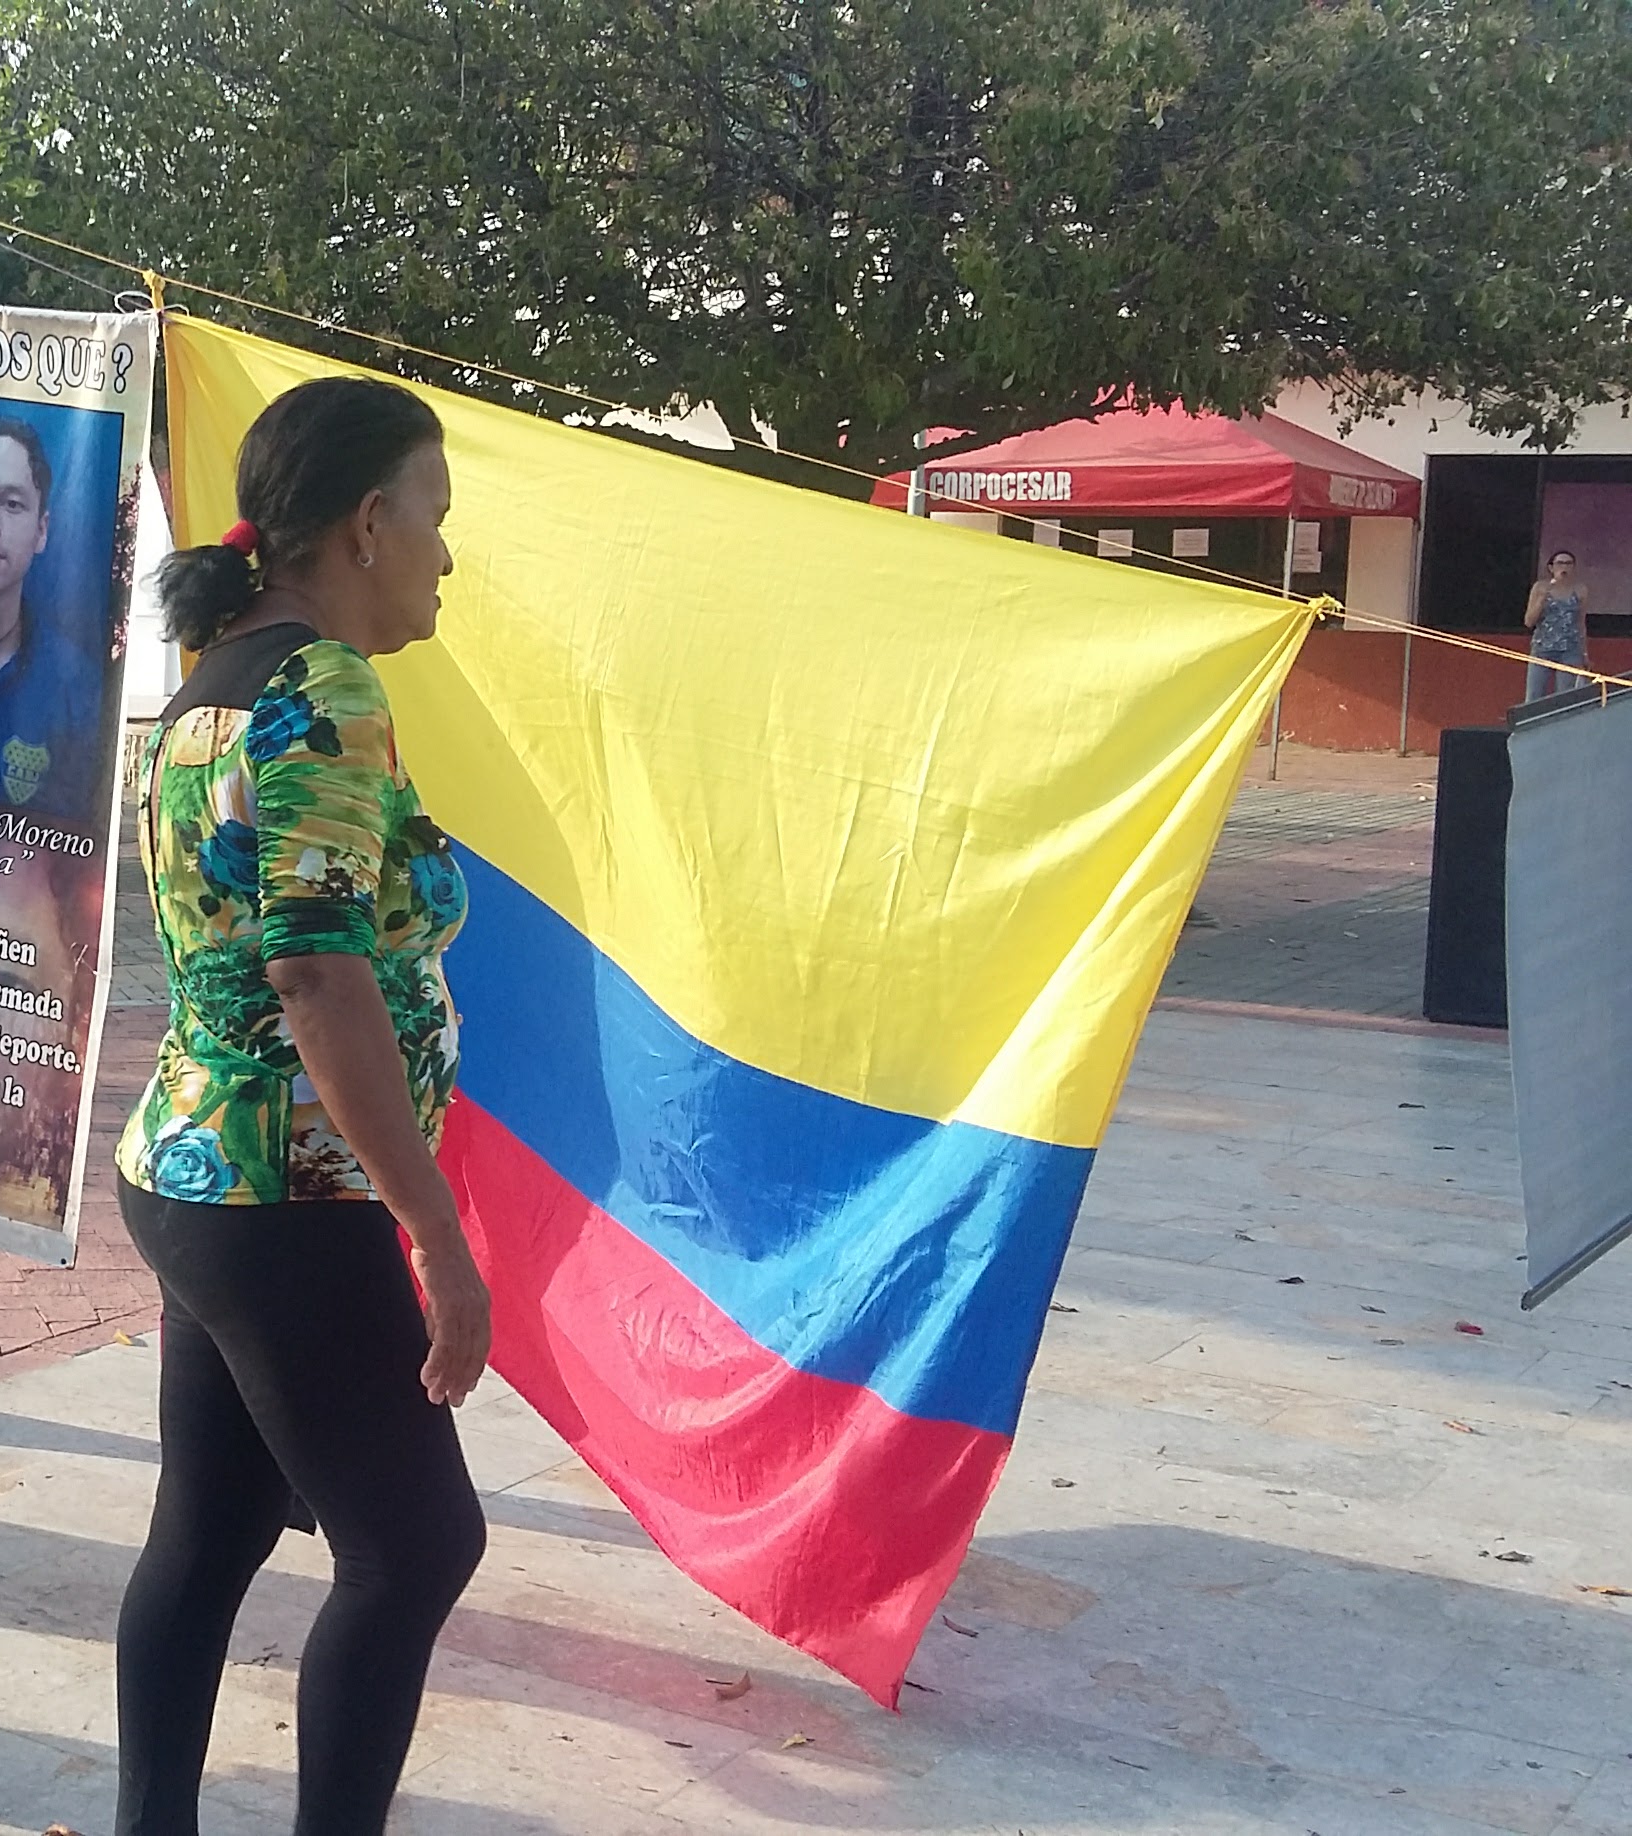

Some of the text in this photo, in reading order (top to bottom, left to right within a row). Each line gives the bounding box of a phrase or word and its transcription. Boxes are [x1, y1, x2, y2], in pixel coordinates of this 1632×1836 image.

[37, 335, 106, 396] QUE
[929, 471, 1072, 501] CORPOCESAR
[3, 1076, 25, 1107] la
